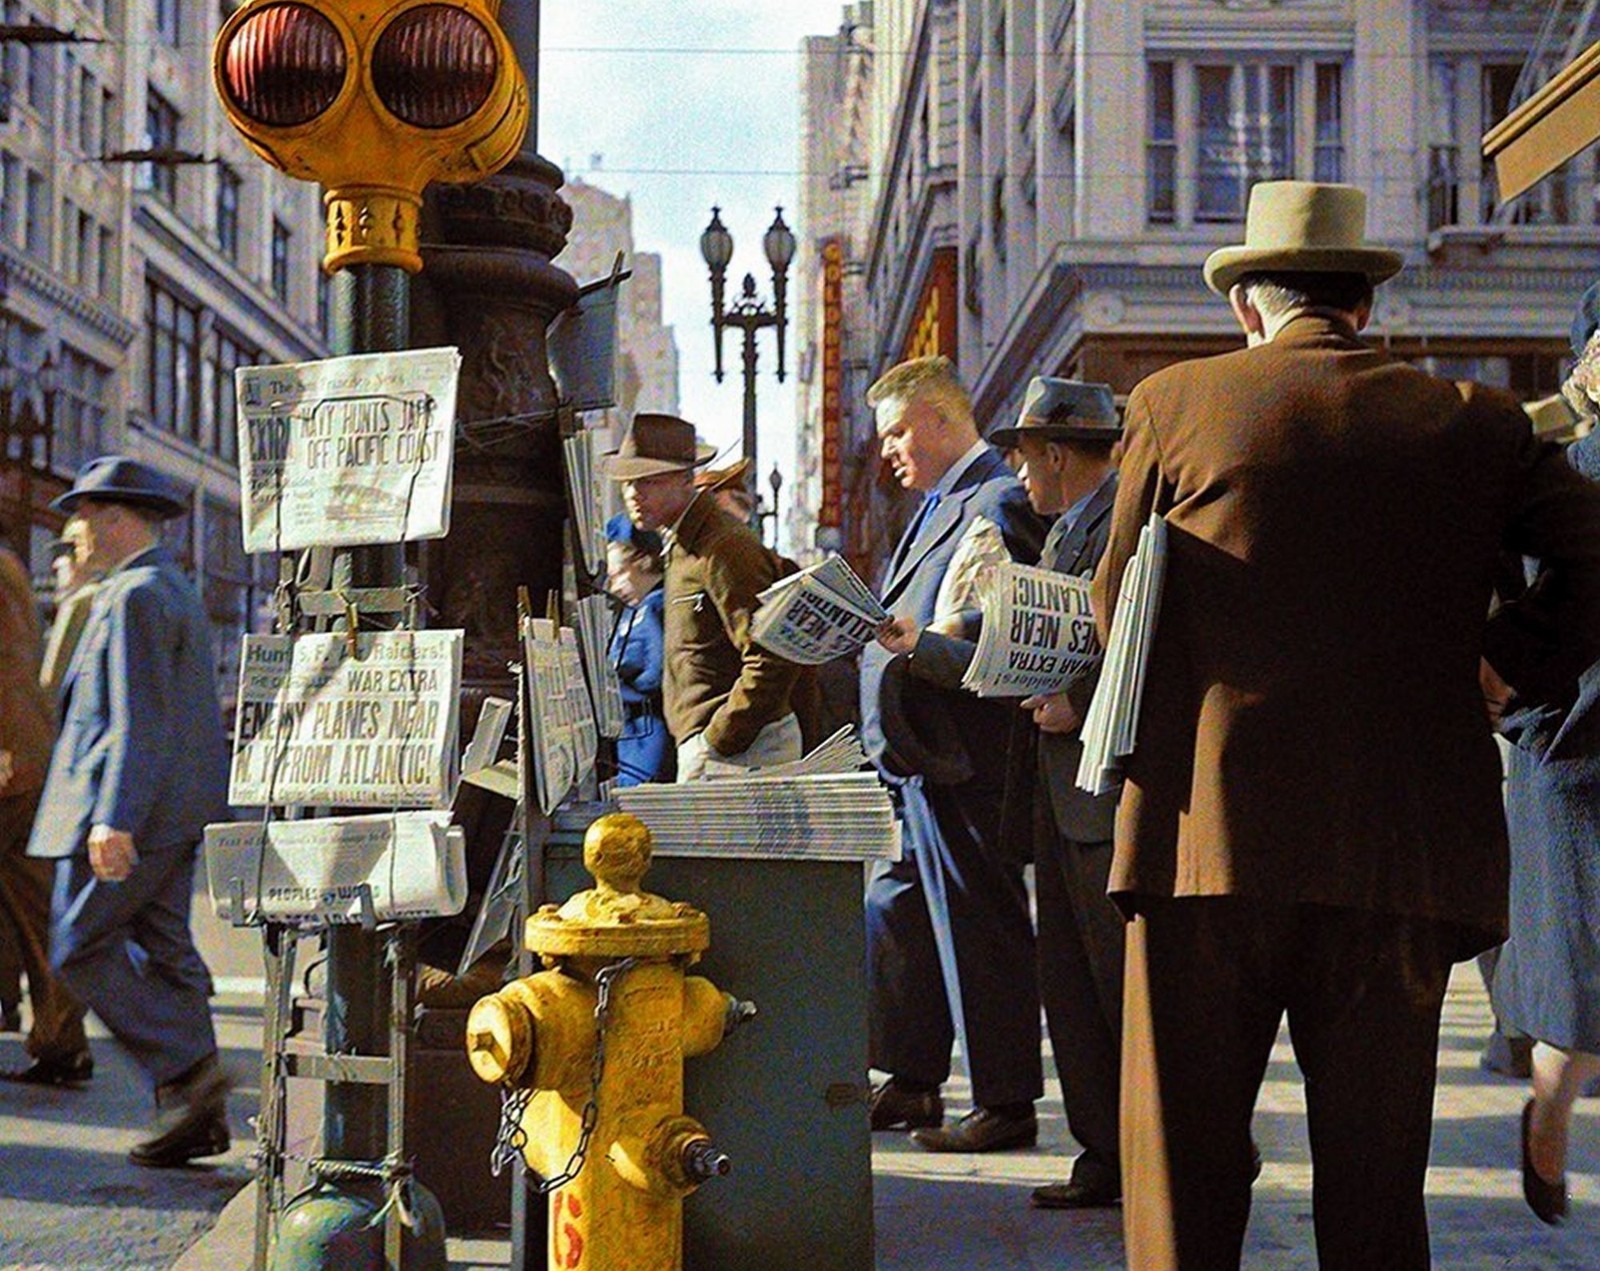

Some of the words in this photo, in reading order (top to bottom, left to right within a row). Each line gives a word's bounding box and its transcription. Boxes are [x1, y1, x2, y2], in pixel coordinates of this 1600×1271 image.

[342, 400, 391, 435] HUNTS
[307, 437, 333, 470] OFF
[336, 433, 390, 467] PACIFIC
[396, 429, 444, 465] COAST
[1012, 575, 1093, 618] TLANTIC!
[787, 599, 833, 642] NEAR
[1010, 608, 1061, 650] NEAR
[373, 639, 446, 661] Raiders!
[1009, 650, 1058, 674] EXTRA
[1060, 658, 1095, 676] WAR
[347, 669, 383, 693] WAR
[388, 669, 439, 692] EXTRA
[240, 699, 306, 741] ENEMY
[312, 700, 382, 741] PLANES
[389, 699, 441, 740] NEAR
[280, 745, 333, 786] FROM
[339, 744, 434, 786] ATLANTIC!
